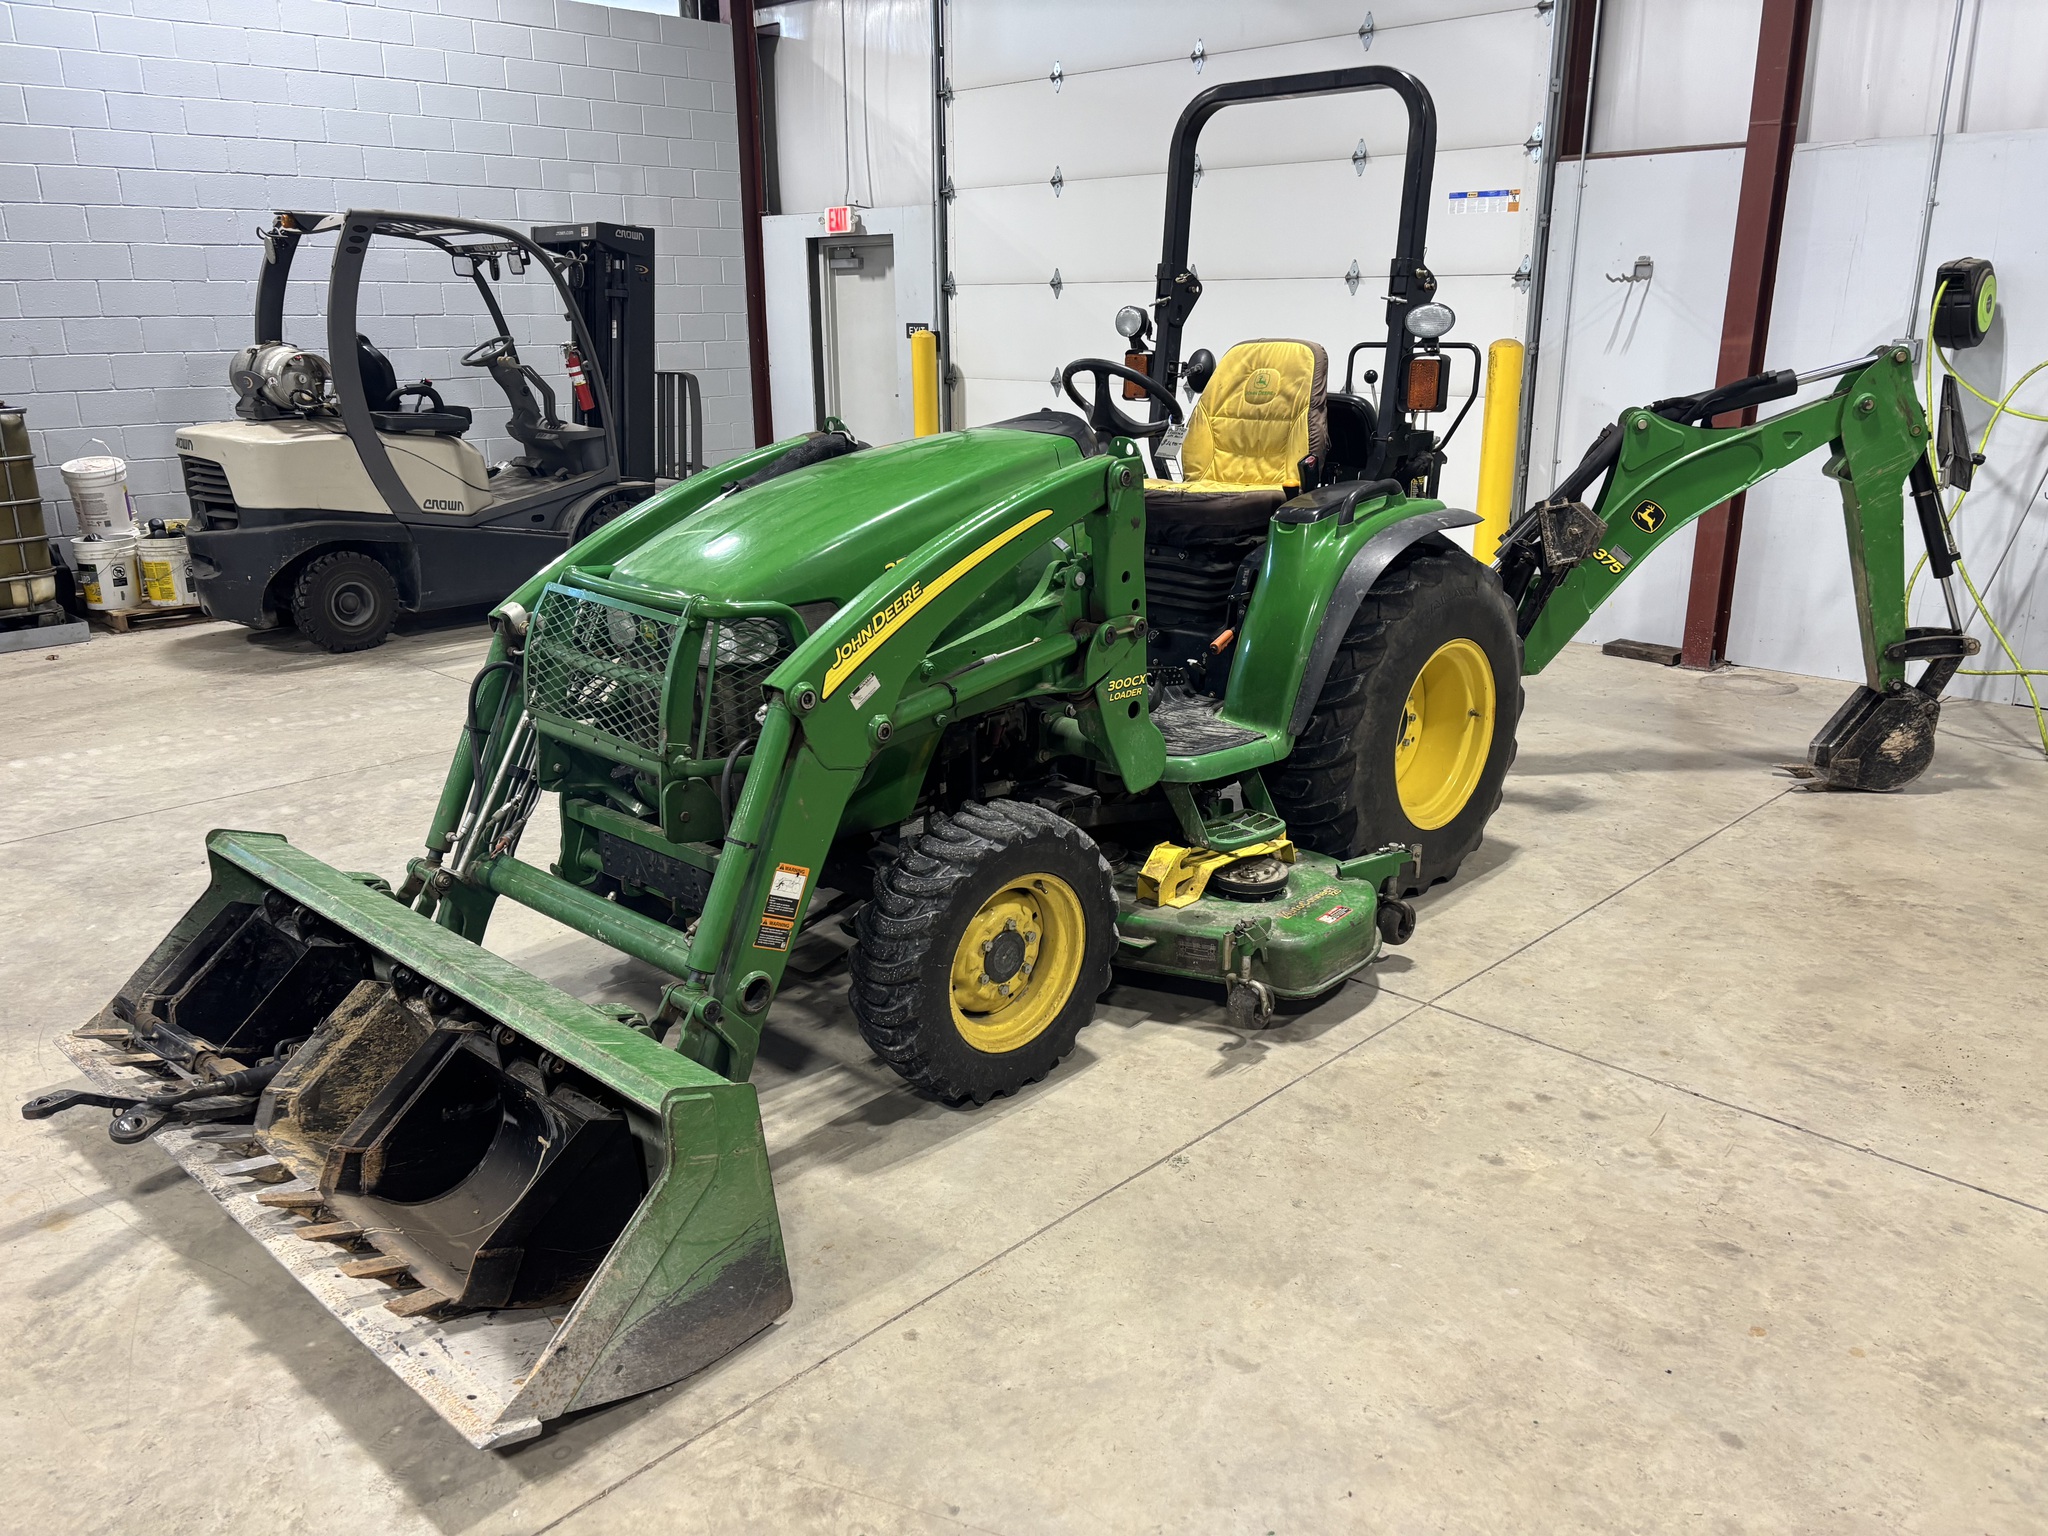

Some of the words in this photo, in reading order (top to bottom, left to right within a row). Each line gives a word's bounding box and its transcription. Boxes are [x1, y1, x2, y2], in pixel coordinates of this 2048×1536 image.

[828, 207, 848, 232] EXIT
[615, 229, 645, 241] CROWN
[423, 499, 465, 511] CROWN
[1592, 548, 1626, 574] 375
[832, 623, 873, 669] JOHN
[871, 580, 923, 633] DEERE
[1107, 674, 1147, 691] 300CX
[1109, 687, 1143, 702] LOADER
[785, 866, 806, 875] WARNING
[769, 920, 790, 929] WARNING
